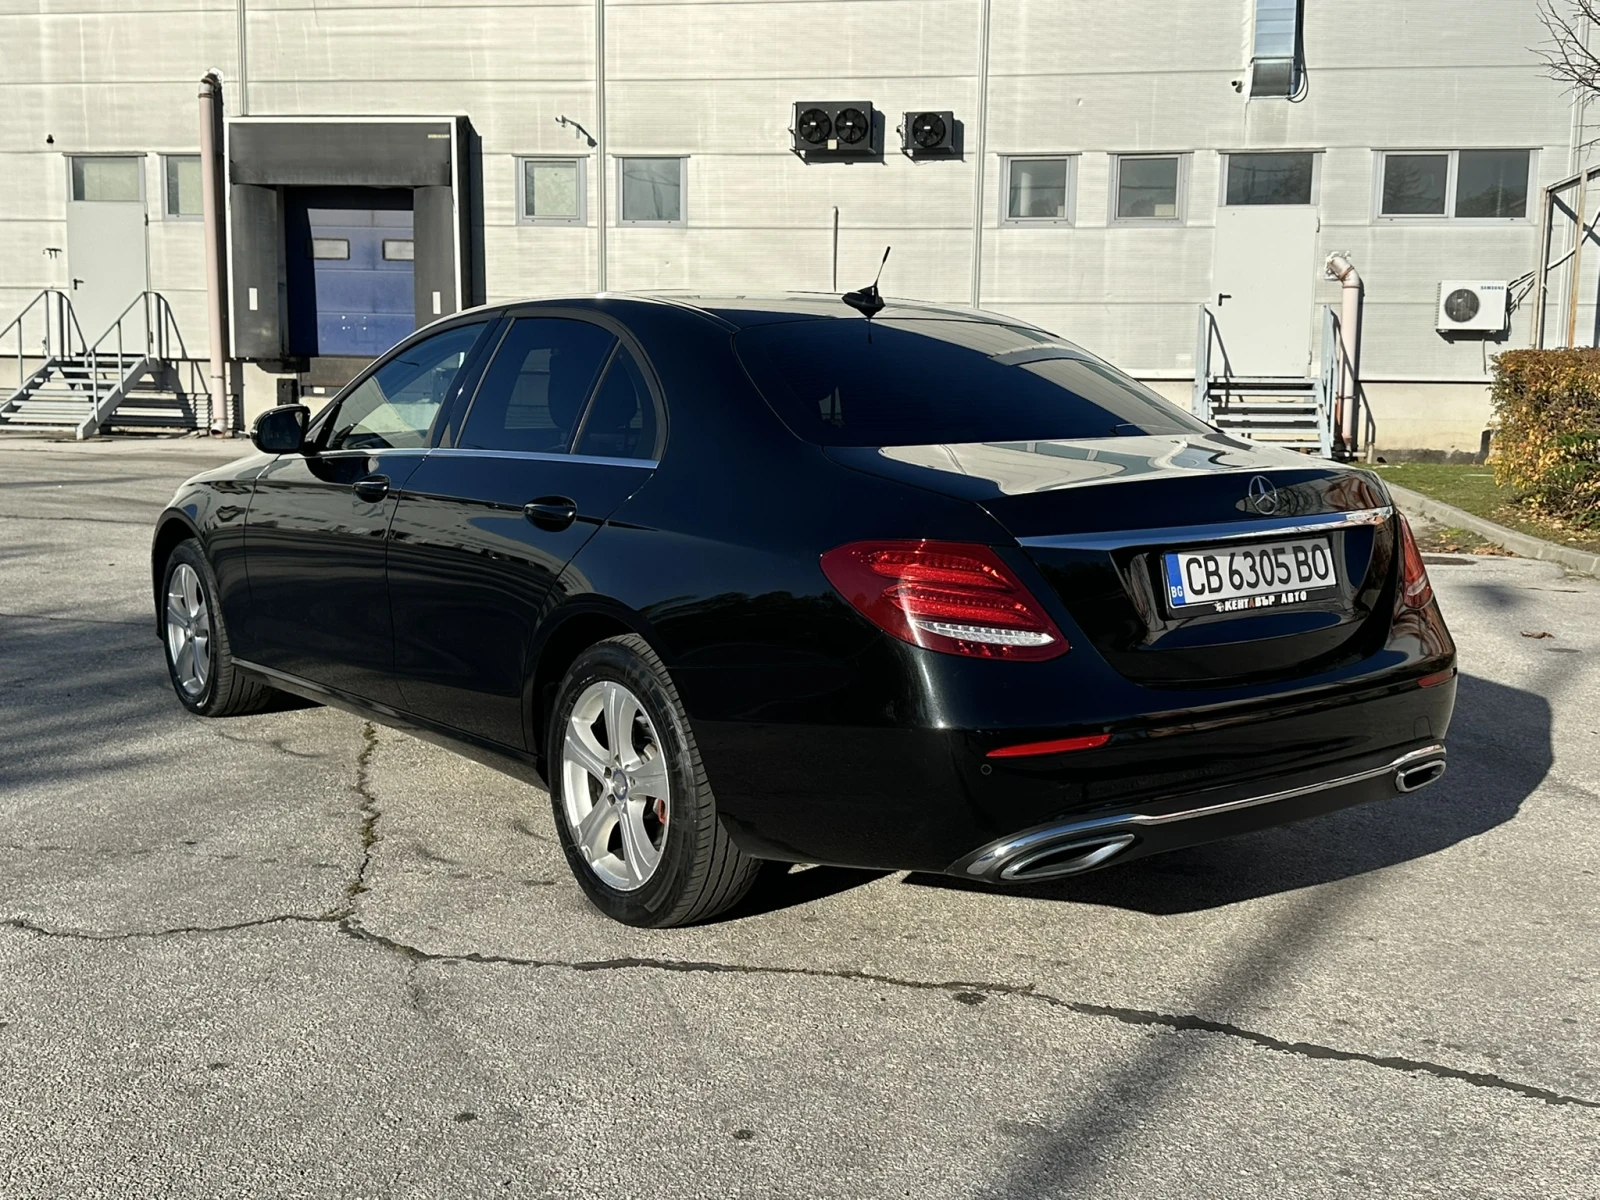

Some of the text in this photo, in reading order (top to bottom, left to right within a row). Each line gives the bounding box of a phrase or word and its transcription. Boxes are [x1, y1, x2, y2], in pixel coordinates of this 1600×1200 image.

[1171, 586, 1183, 598] BG
[1225, 591, 1307, 612] КЕНТАВЪР АВТО
